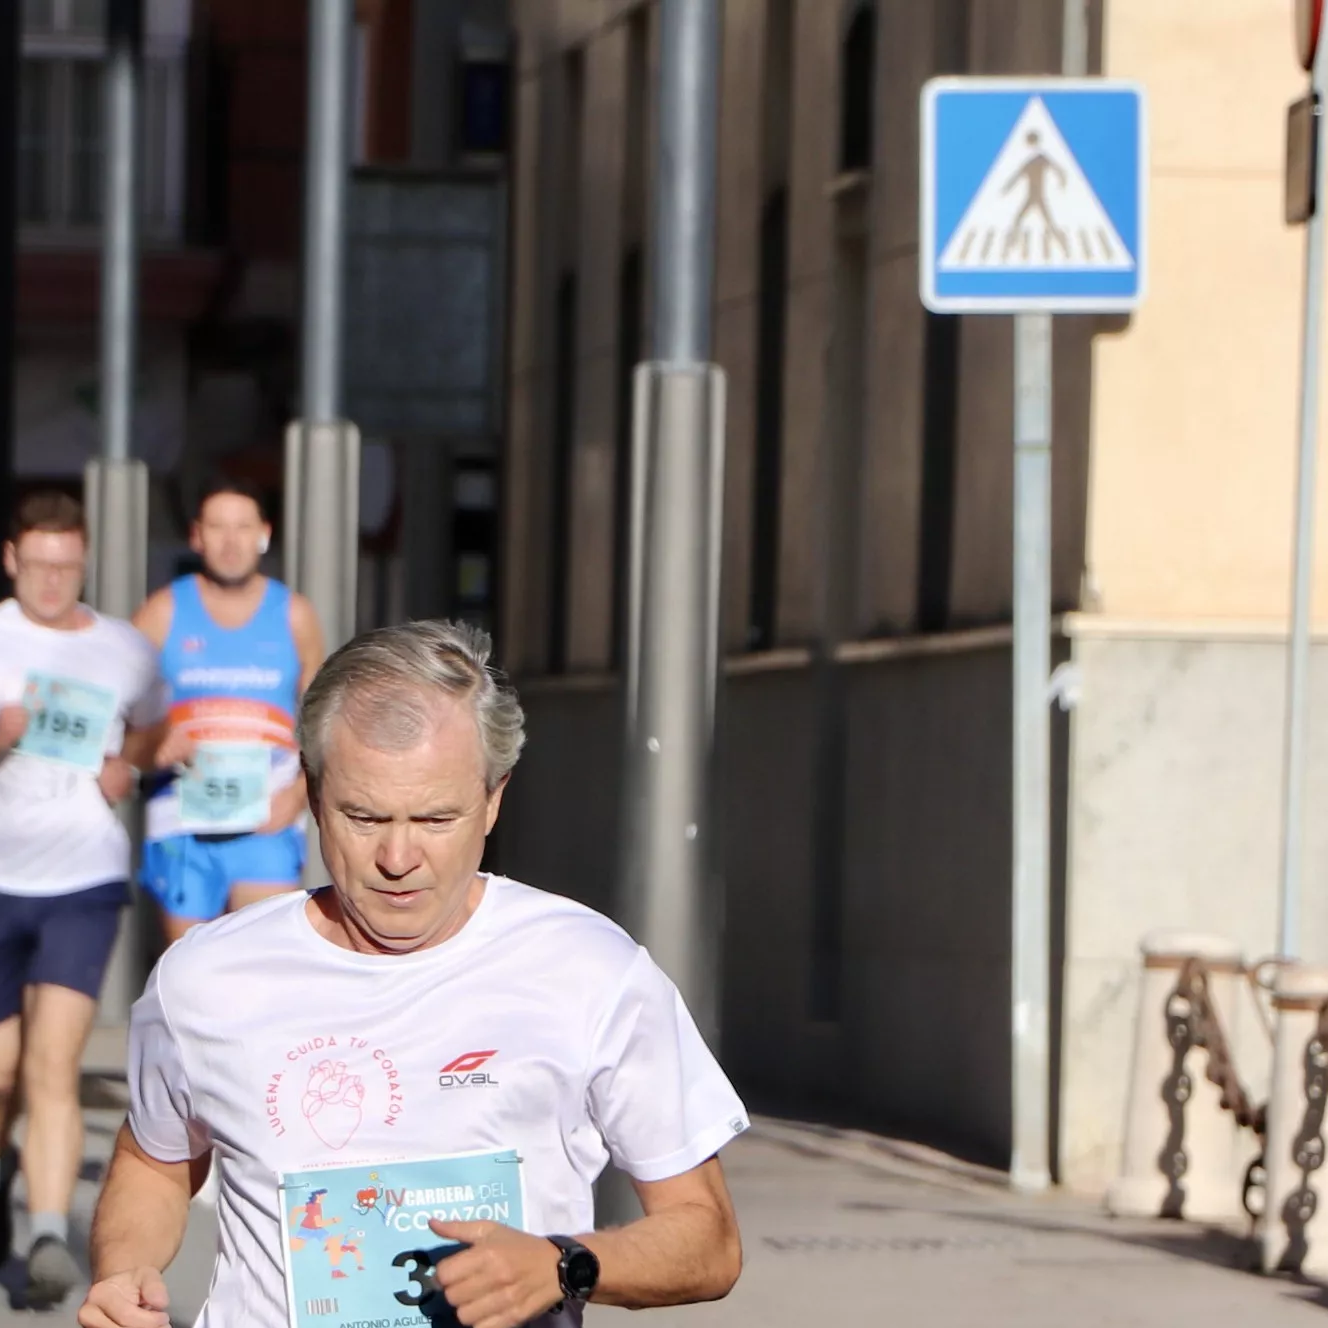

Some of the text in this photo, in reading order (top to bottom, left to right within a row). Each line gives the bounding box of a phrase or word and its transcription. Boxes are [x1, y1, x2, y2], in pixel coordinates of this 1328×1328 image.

[37, 709, 89, 742] 195
[287, 1036, 337, 1061] CUIDA
[350, 1037, 368, 1049] TU
[373, 1049, 403, 1126] CORAZÓN
[385, 1182, 508, 1207] IV CARRERA DEL
